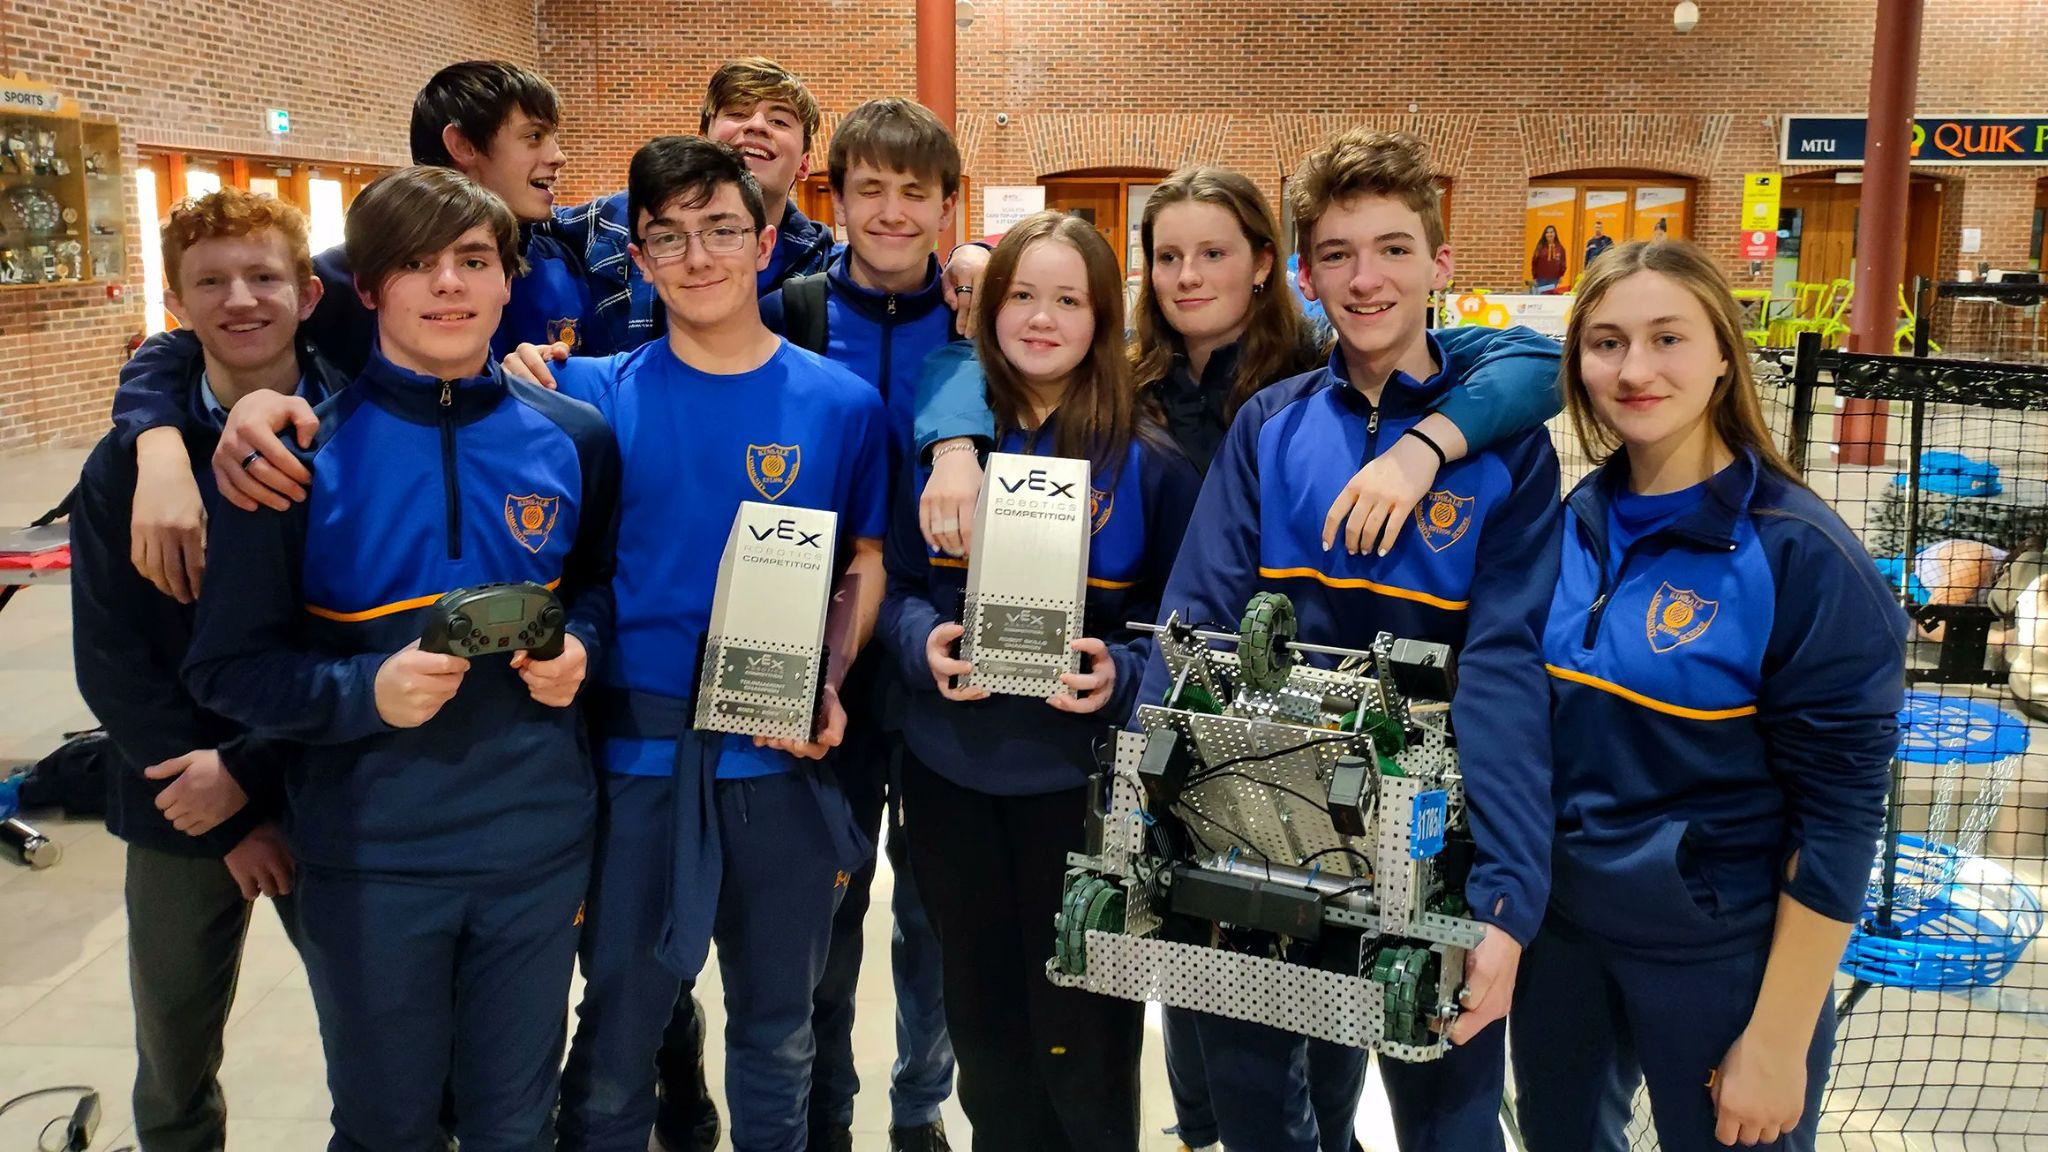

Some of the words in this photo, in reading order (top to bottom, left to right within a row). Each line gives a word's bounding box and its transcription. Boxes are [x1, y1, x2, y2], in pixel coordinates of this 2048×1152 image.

[5, 91, 43, 105] SPORTS
[1801, 139, 1836, 152] MTU
[1934, 123, 2025, 157] QUIK
[998, 470, 1076, 499] VEX
[995, 498, 1077, 511] ROBOTICS
[994, 508, 1076, 521] COMPETITION
[748, 519, 823, 548] VEX
[744, 545, 822, 560] ROBOTICS
[743, 555, 820, 570] COMPETITION
[1006, 609, 1044, 624] VEX
[748, 654, 784, 669] VEX
